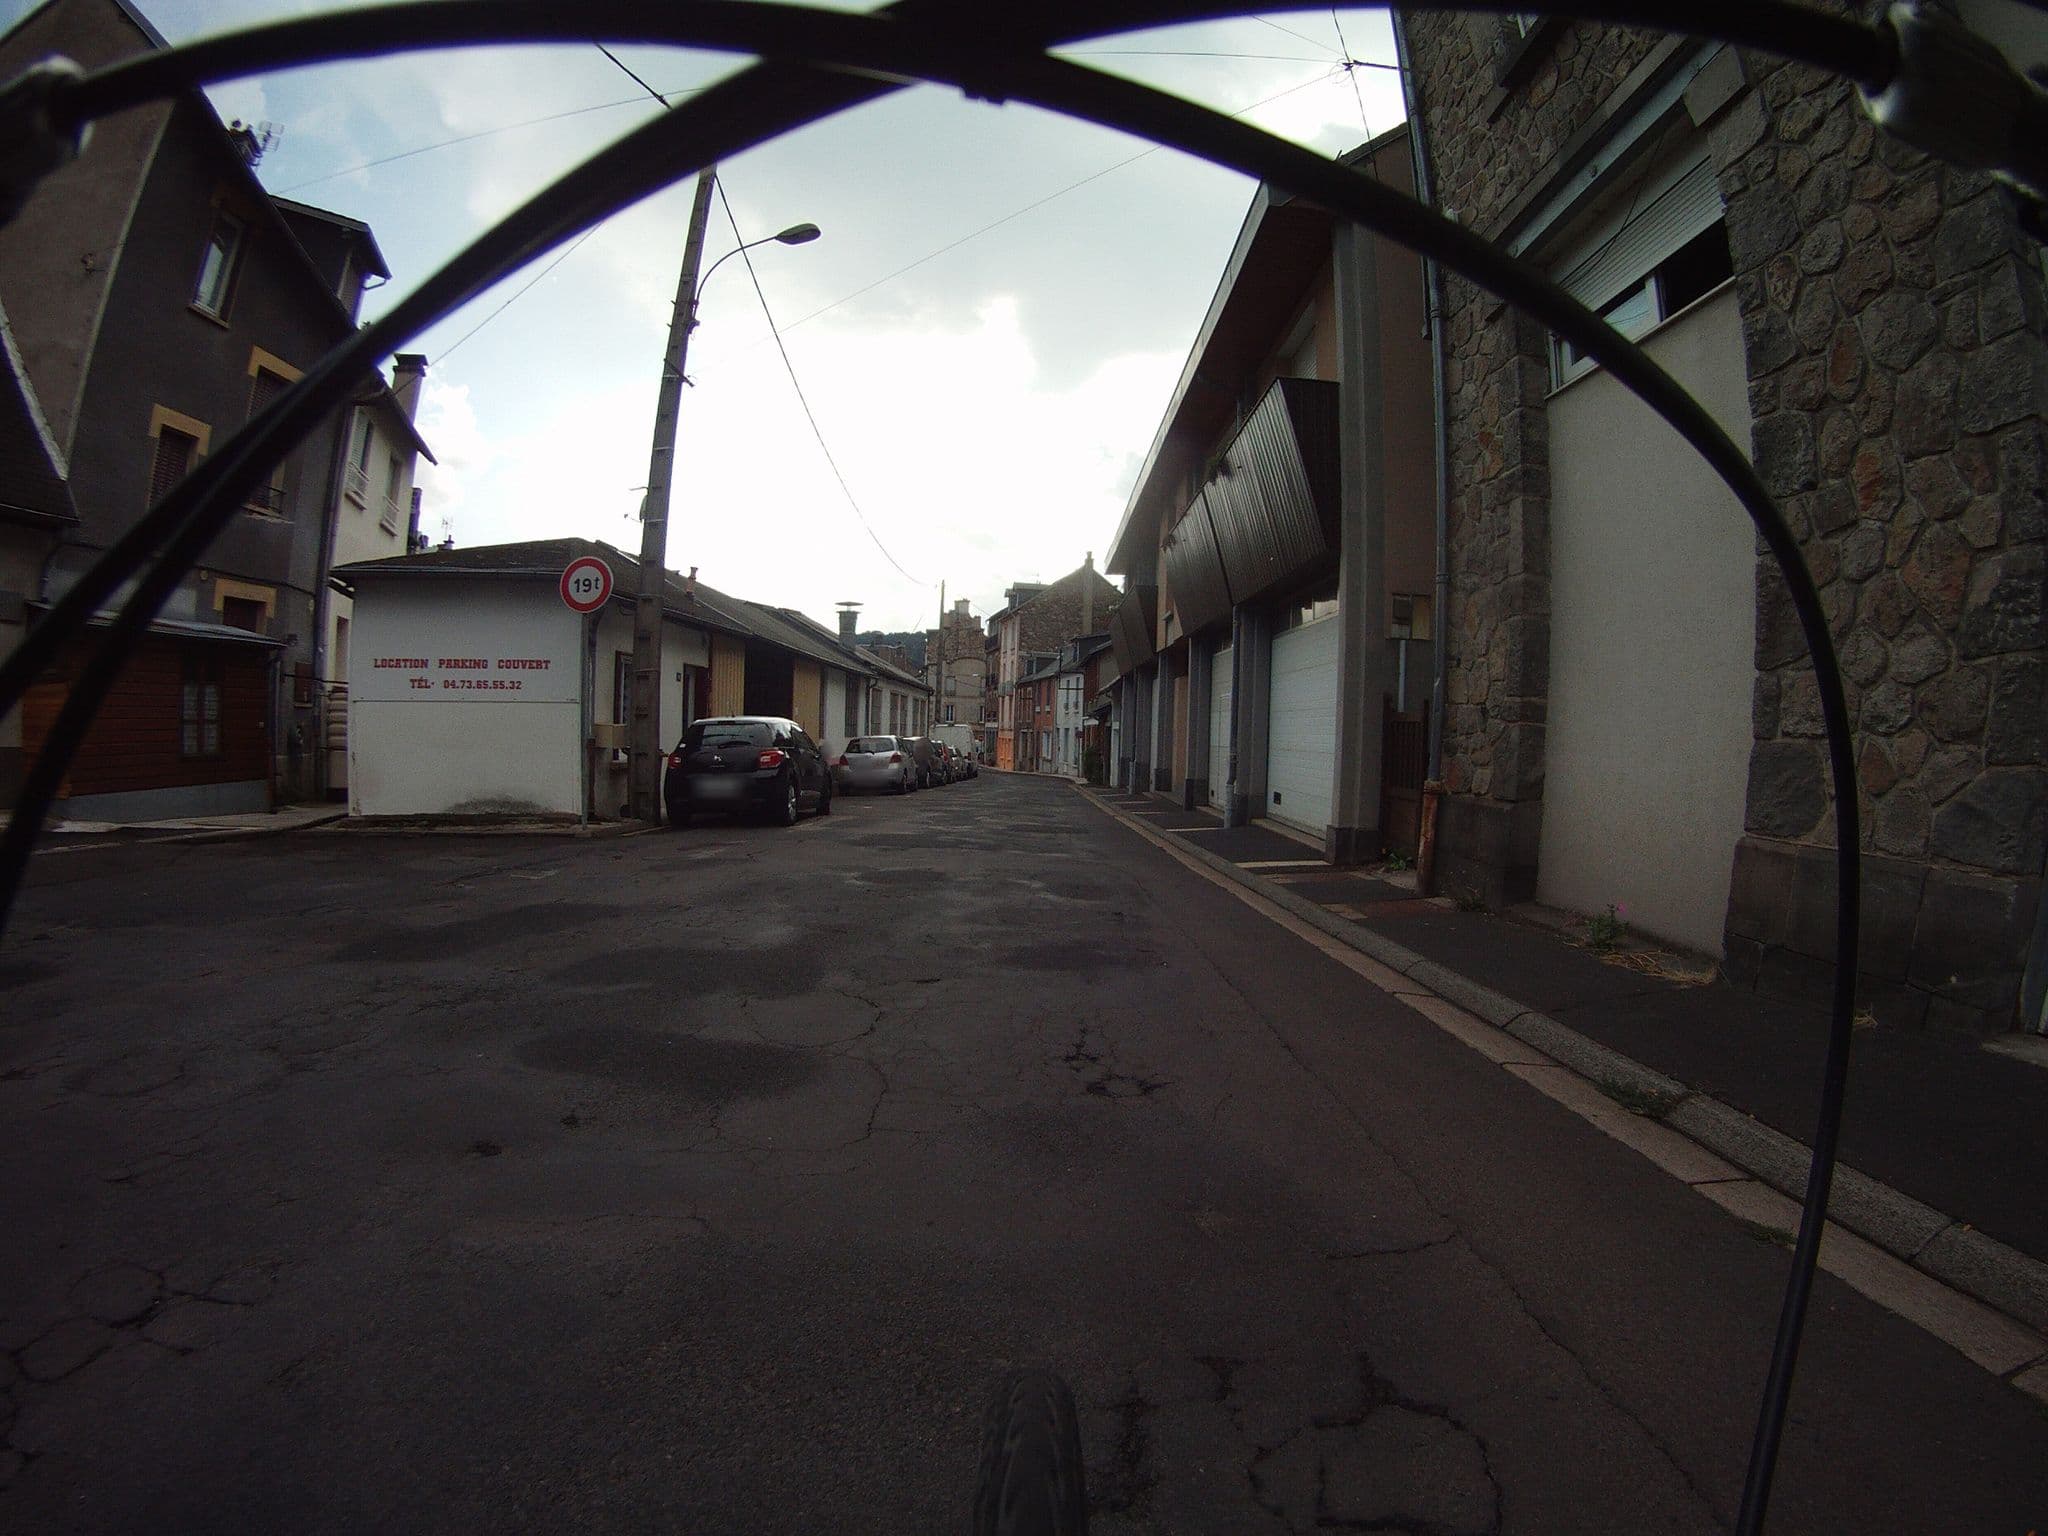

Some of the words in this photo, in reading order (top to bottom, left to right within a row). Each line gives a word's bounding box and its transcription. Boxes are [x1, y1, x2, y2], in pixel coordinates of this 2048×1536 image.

[373, 658, 429, 669] LOCATION
[438, 659, 488, 669] PARKING
[497, 659, 551, 670] COUVERT
[443, 680, 522, 690] 04.73.65.55.32
